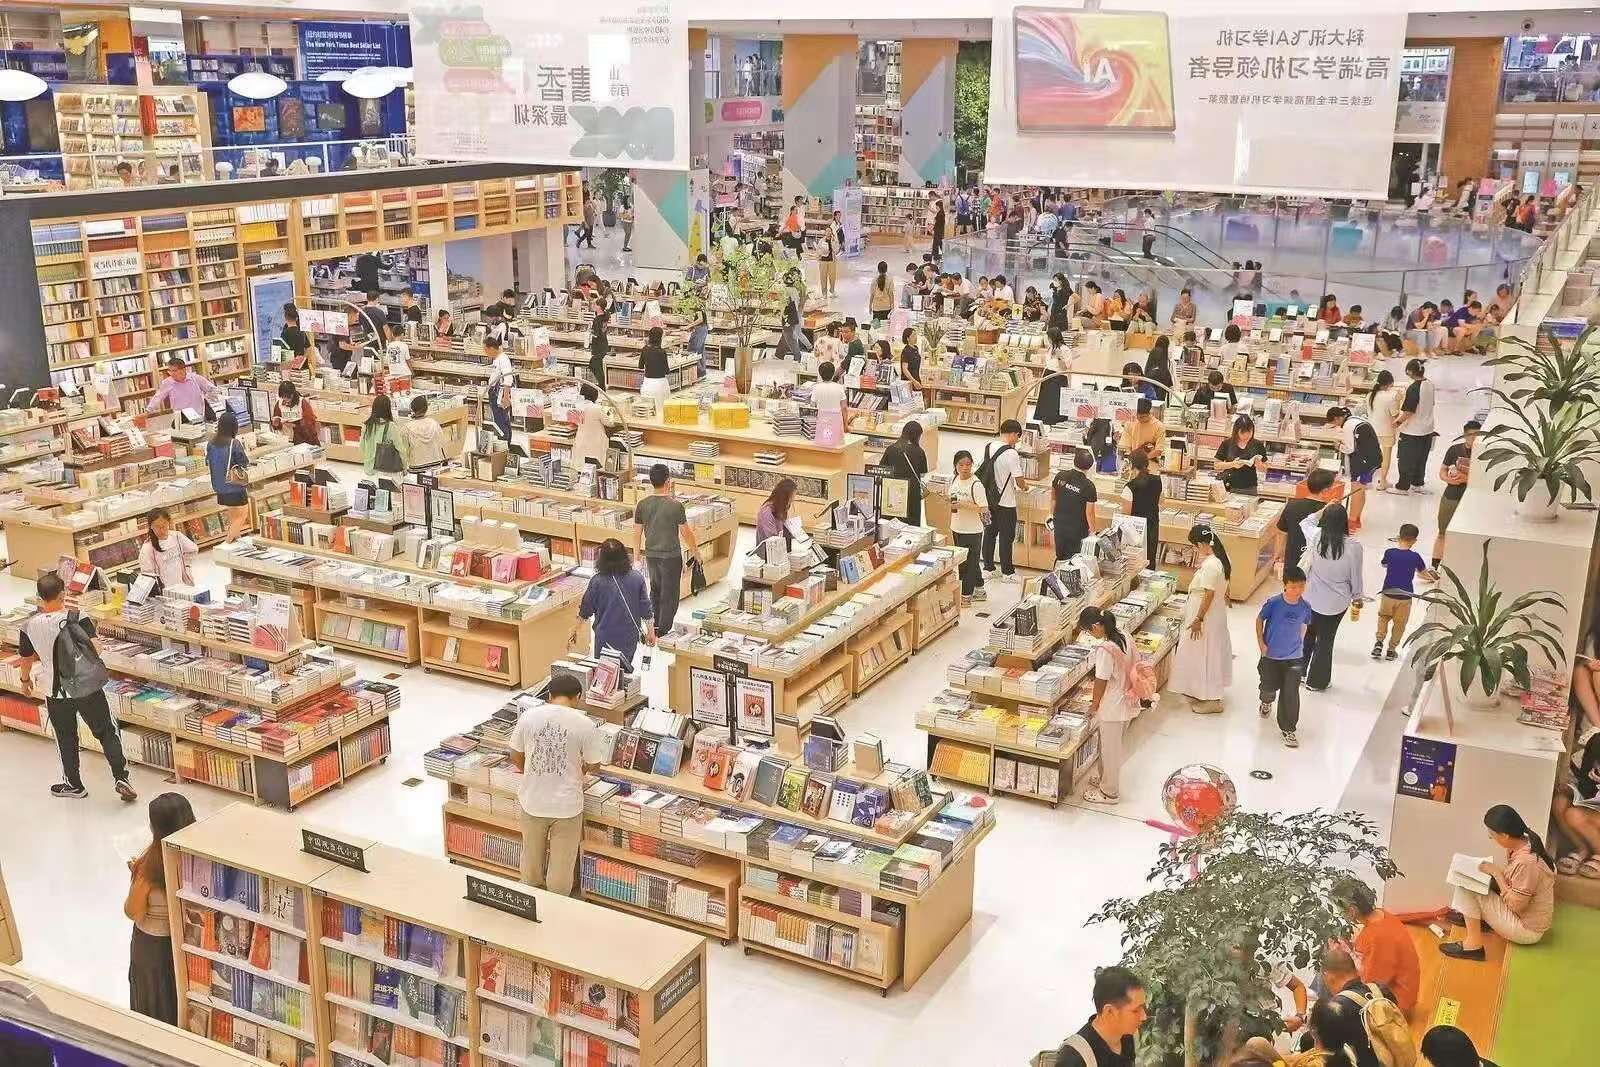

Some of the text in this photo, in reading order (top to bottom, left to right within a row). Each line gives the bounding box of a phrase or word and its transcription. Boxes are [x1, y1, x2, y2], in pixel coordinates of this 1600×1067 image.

[315, 41, 325, 49] New
[308, 834, 361, 860] 中国现当代小说
[471, 880, 532, 908] 中国现当代小说
